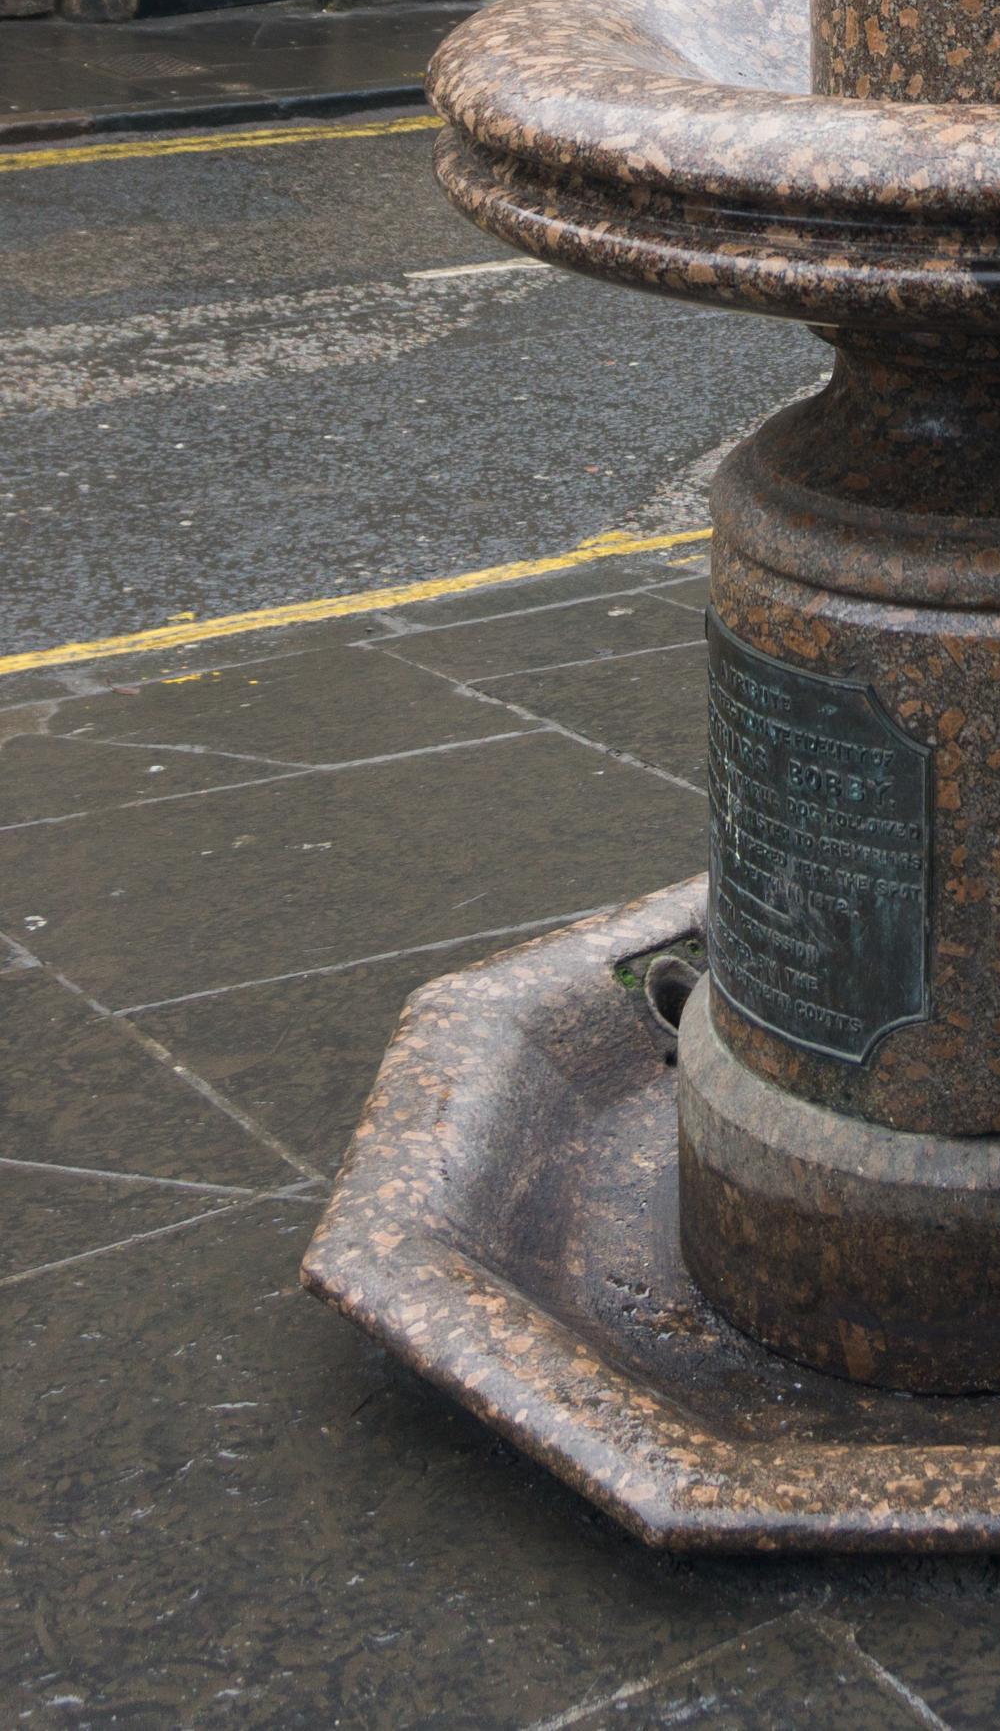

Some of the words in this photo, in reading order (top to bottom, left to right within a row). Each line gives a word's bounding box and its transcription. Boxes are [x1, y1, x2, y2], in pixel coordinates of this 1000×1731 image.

[729, 666, 793, 713] TRIBUTE
[793, 730, 867, 765] FIDELITY
[870, 746, 895, 767] OF
[786, 795, 822, 820] DOG
[824, 806, 922, 841] FOLLOWED
[794, 829, 815, 849] TO
[818, 836, 923, 873] GREYFRIARS
[835, 867, 872, 893] THE
[873, 877, 923, 903] SPOT
[784, 965, 819, 990] THE
